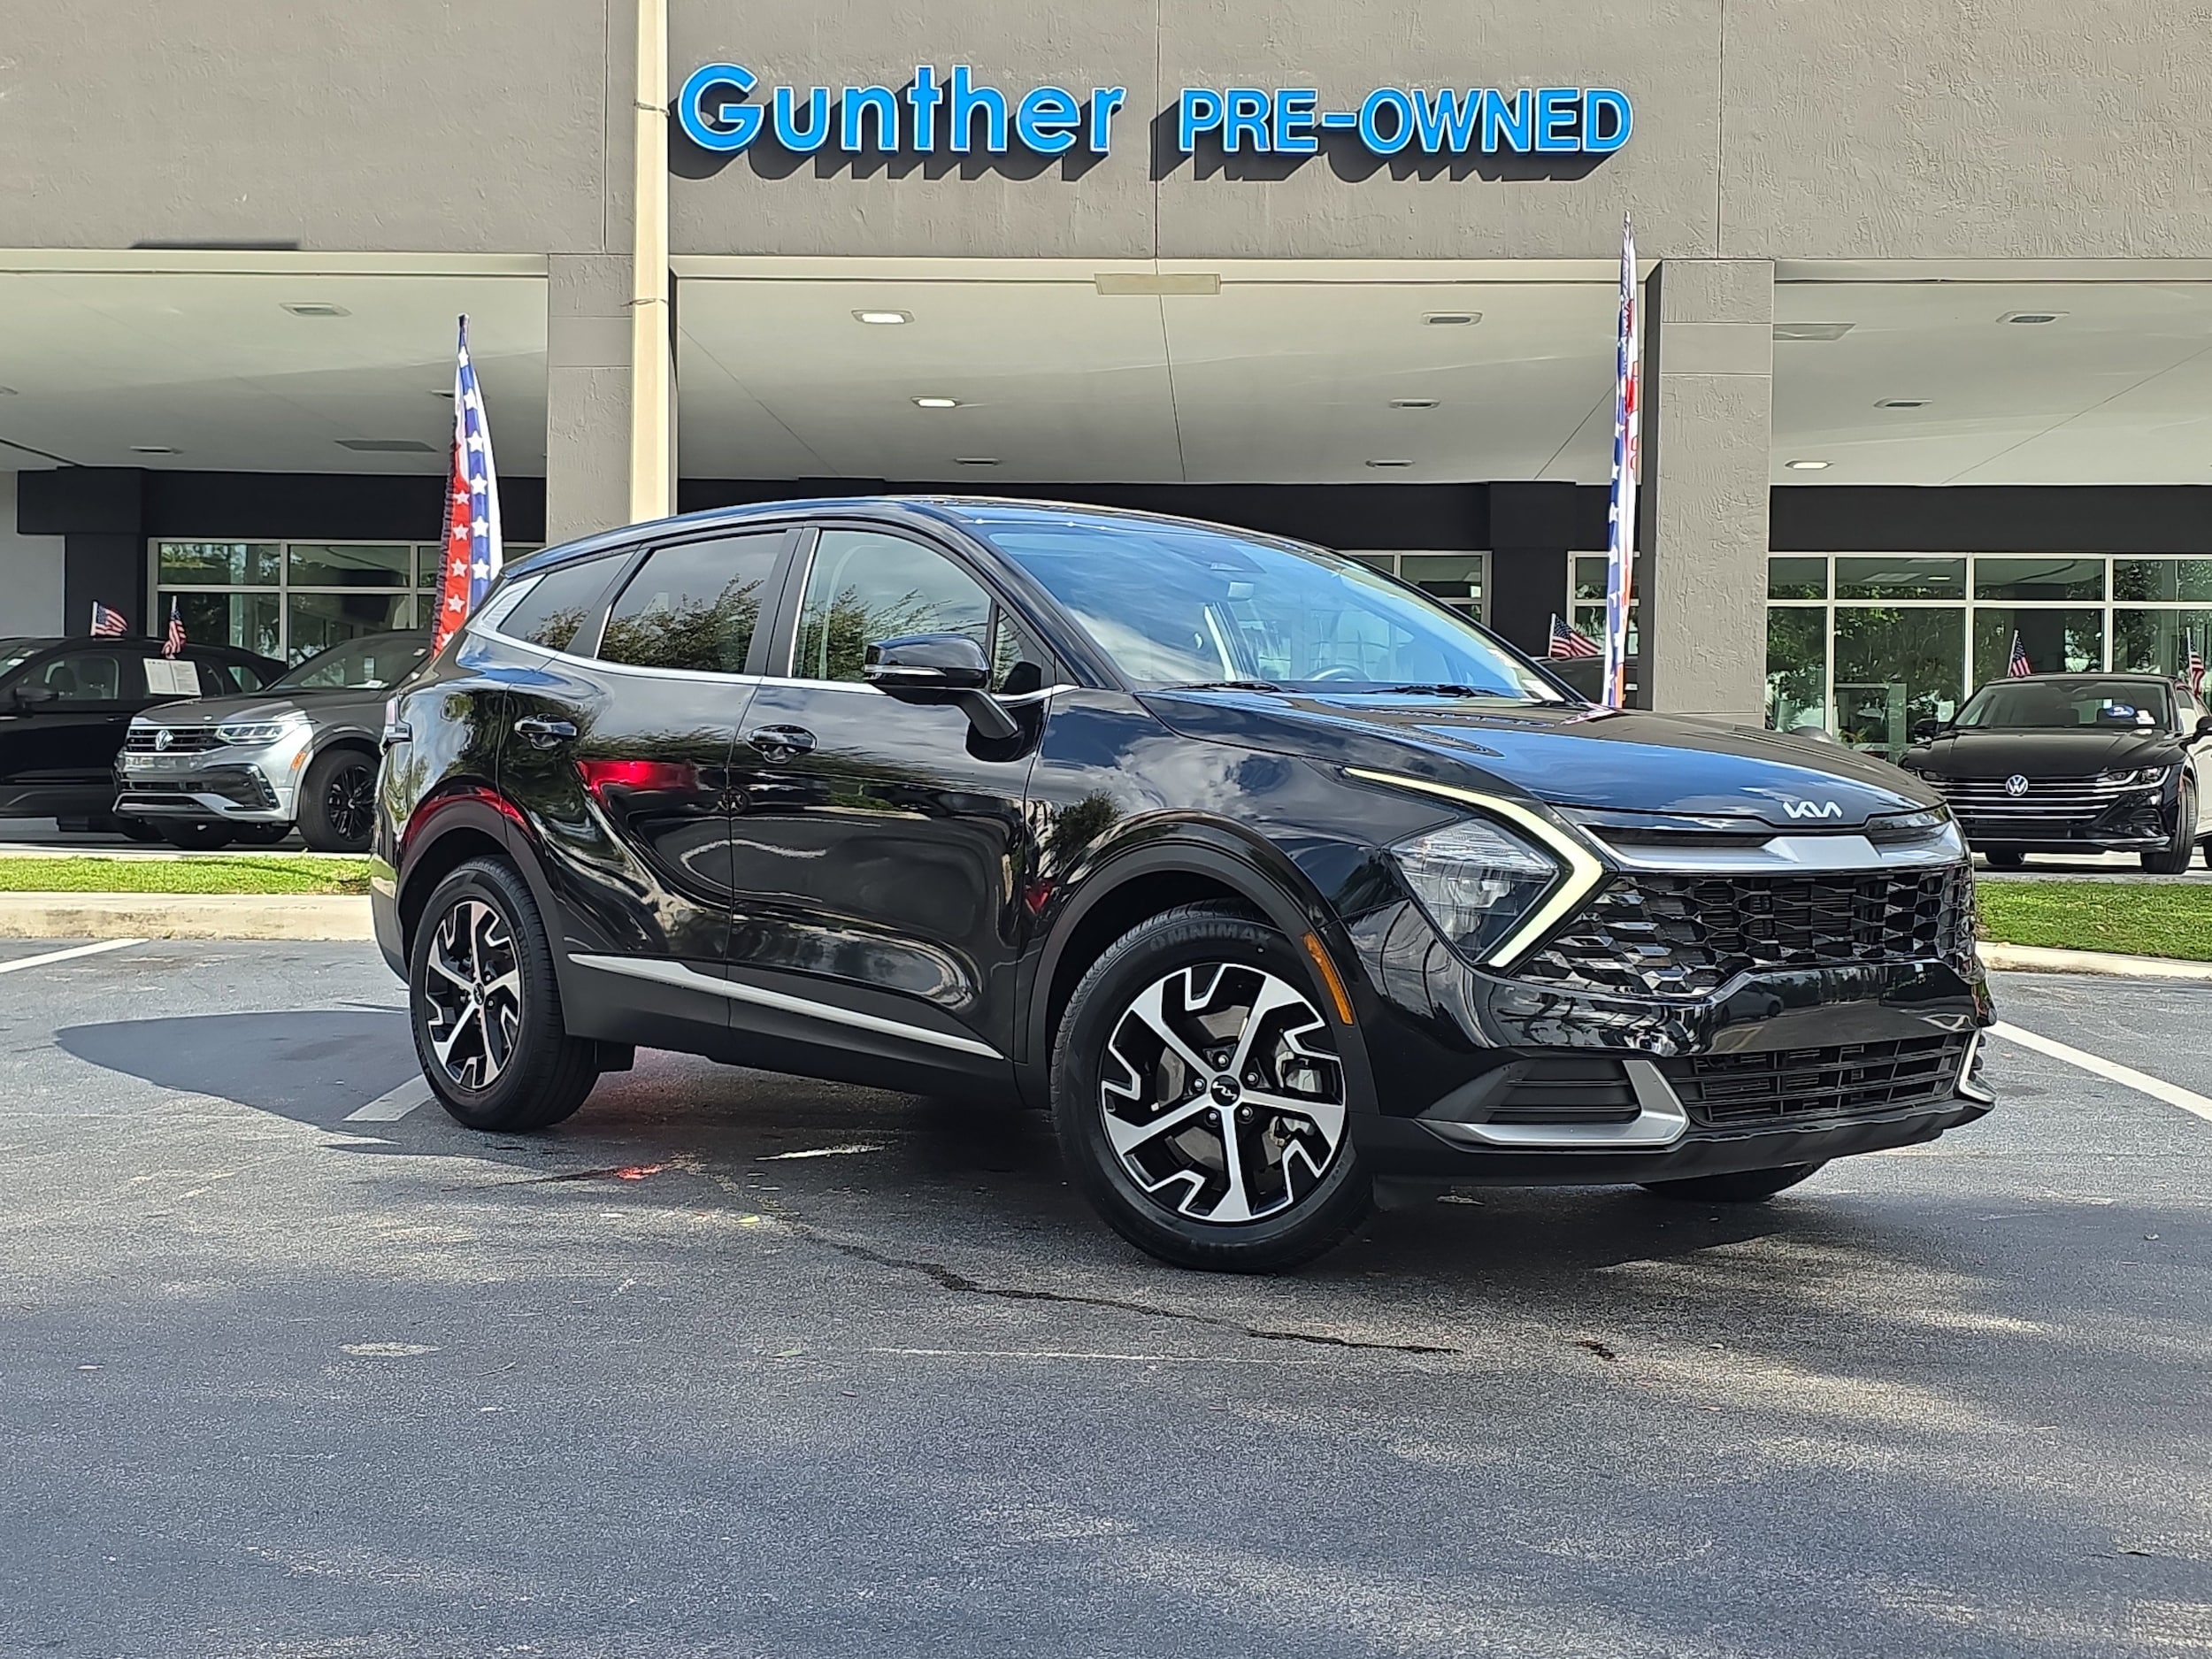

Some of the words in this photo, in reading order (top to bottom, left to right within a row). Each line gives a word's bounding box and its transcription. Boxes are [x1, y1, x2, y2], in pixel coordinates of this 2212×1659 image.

[678, 62, 1127, 154] Gunther
[1179, 87, 1634, 154] PRE-OWNED
[1782, 801, 1843, 818] KIA
